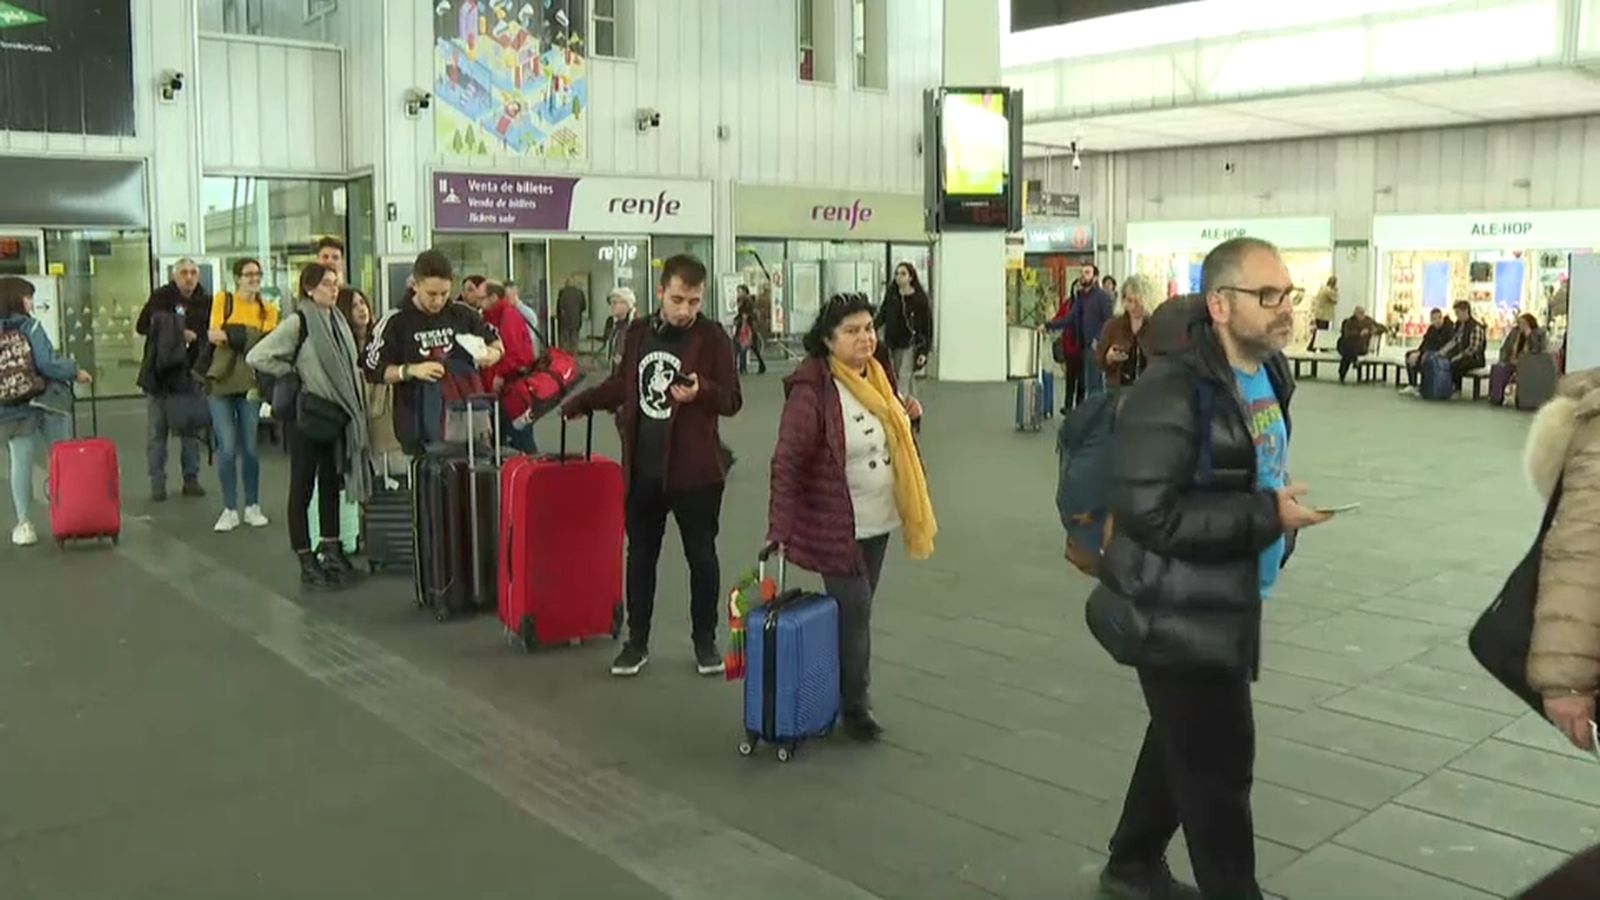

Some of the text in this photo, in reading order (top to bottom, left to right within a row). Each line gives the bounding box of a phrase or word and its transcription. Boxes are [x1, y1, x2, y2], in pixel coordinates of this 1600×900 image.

[468, 179, 553, 194] Venta de billetes
[496, 199, 507, 209] de
[608, 190, 681, 224] renfe
[811, 198, 873, 231] renfe
[1471, 222, 1532, 236] ALE-HOP
[413, 327, 454, 342] CHICAGO
